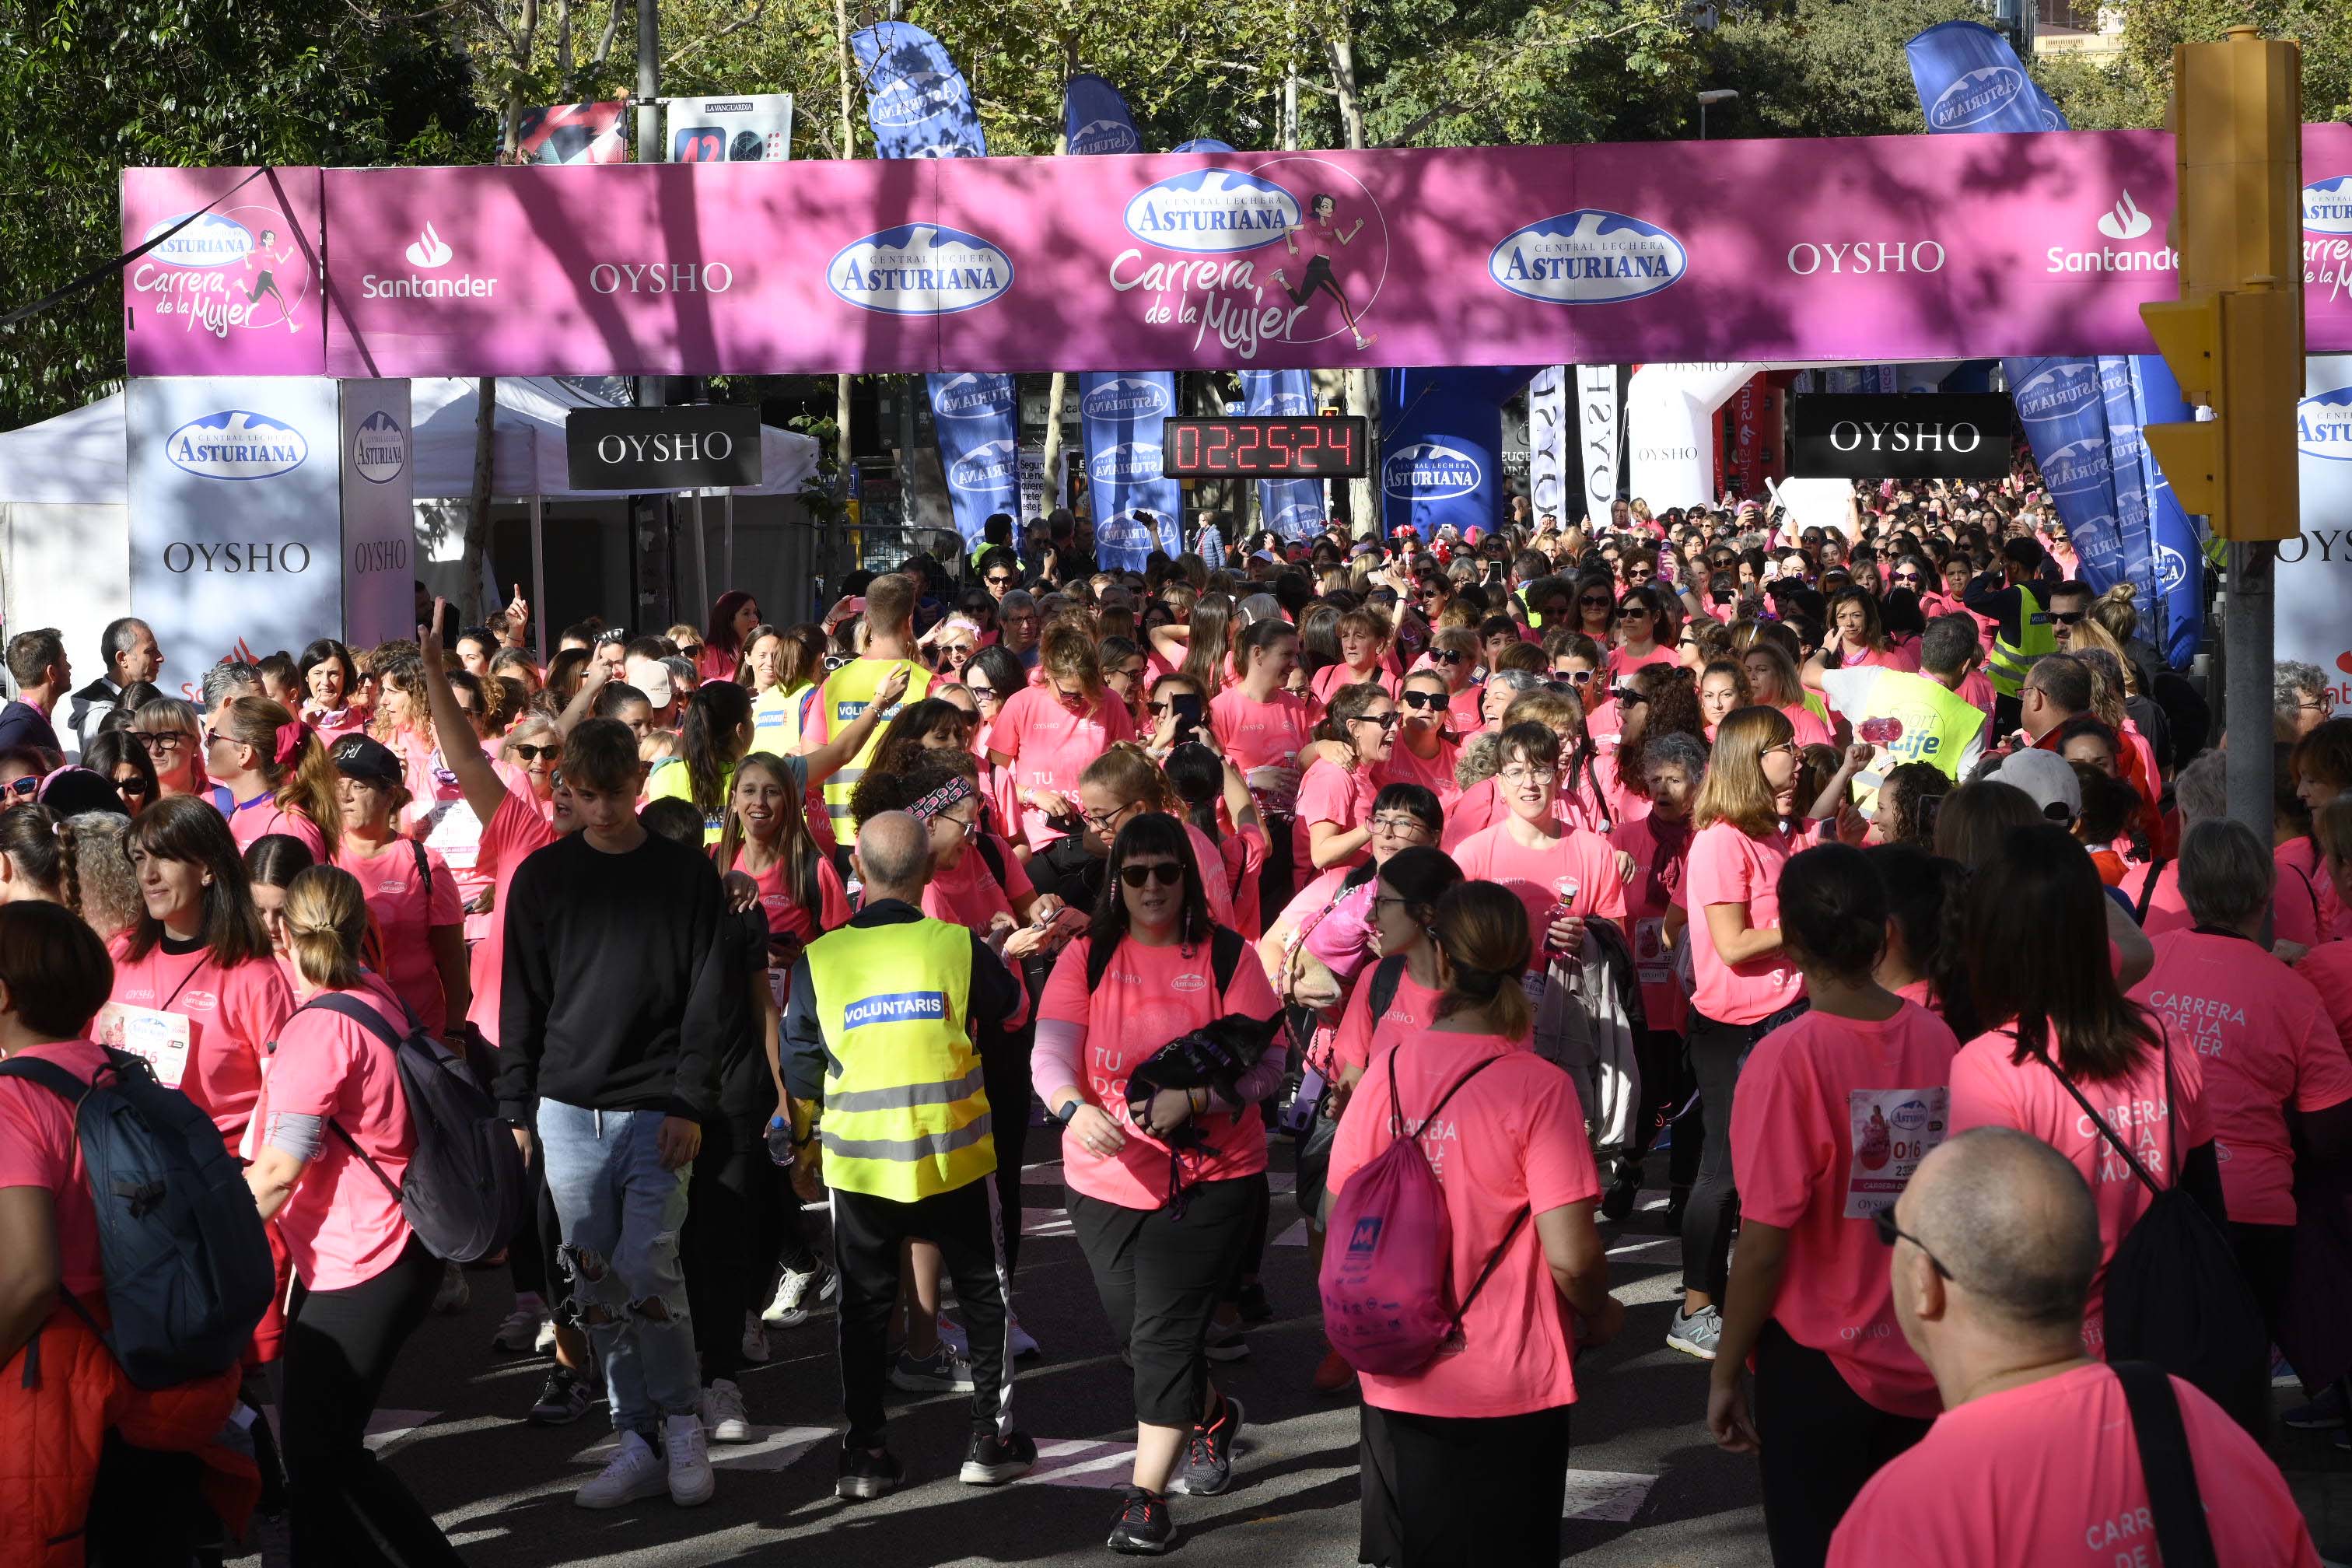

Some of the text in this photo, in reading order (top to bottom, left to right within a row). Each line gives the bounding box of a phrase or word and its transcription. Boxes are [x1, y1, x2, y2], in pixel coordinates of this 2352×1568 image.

[1165, 195, 1283, 205] CENTRAL LECHERA
[1138, 204, 1287, 231] ASTURIANA
[870, 254, 928, 264] CENTRAL
[1535, 241, 1665, 253] CENTRAL LECHERA
[1787, 240, 1946, 275] OYSHO
[2046, 245, 2179, 272] Santand
[132, 263, 226, 293] Carrera
[590, 261, 733, 293] OYSHO
[841, 257, 1000, 291] ASTURIANA
[1109, 248, 1255, 292] Carrera
[1503, 246, 1671, 282] ASTURIANA
[362, 272, 498, 299] Santander
[156, 289, 260, 338] de la Mujer
[1145, 285, 1309, 360] de la Mujer
[177, 436, 299, 463] ASTURIANA
[597, 431, 733, 464] OYSHO
[1177, 426, 1350, 468] 02:25:24
[1829, 421, 1980, 453] OYSHO
[357, 440, 402, 466] ASTURIANA
[1638, 446, 1698, 461] OYSHO
[1385, 468, 1474, 488] ASTURIANA
[163, 542, 310, 572] OYSHO
[355, 539, 407, 575] OYSHO
[1032, 771, 1052, 785] TU
[845, 999, 941, 1024] VOLUNTARIS
[2149, 990, 2246, 1026] CARRERA
[2196, 1017, 2221, 1039] LA
[1094, 1047, 1122, 1072] TU
[2077, 1097, 2168, 1139] CRRERA
[2097, 1149, 2165, 1184] MUER
[2085, 1507, 2154, 1552] CARR
